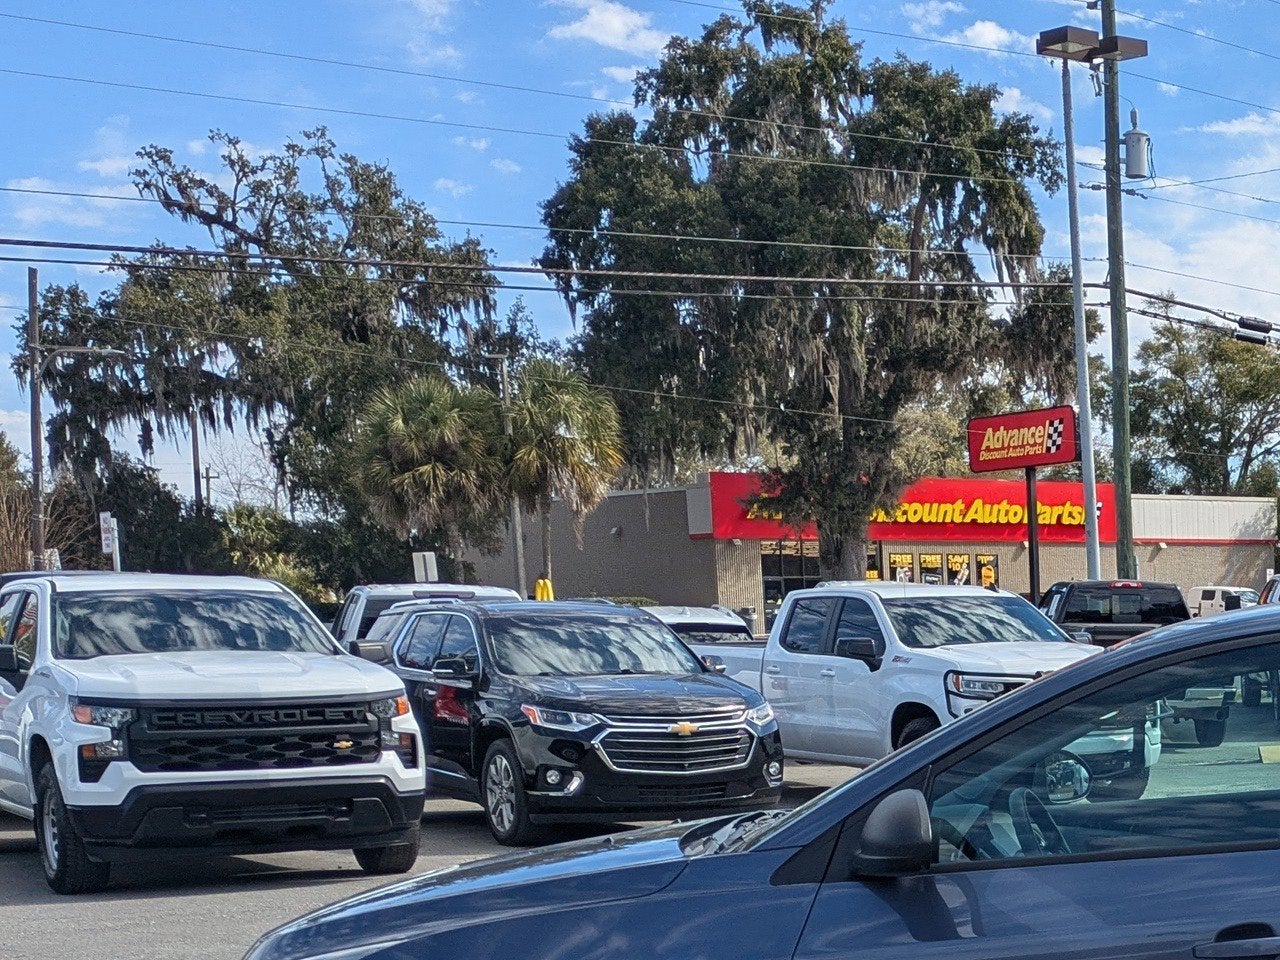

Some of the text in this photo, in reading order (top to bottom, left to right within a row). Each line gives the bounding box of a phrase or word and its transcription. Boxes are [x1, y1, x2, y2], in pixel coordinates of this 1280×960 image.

[981, 425, 1045, 450] Advance
[980, 445, 1043, 460] Discount Auto Parts
[964, 499, 1023, 524] Auto
[890, 554, 913, 563] FREE
[920, 554, 942, 563] FREE
[948, 555, 969, 563] SAVE
[151, 707, 366, 725] CHEVROLET
